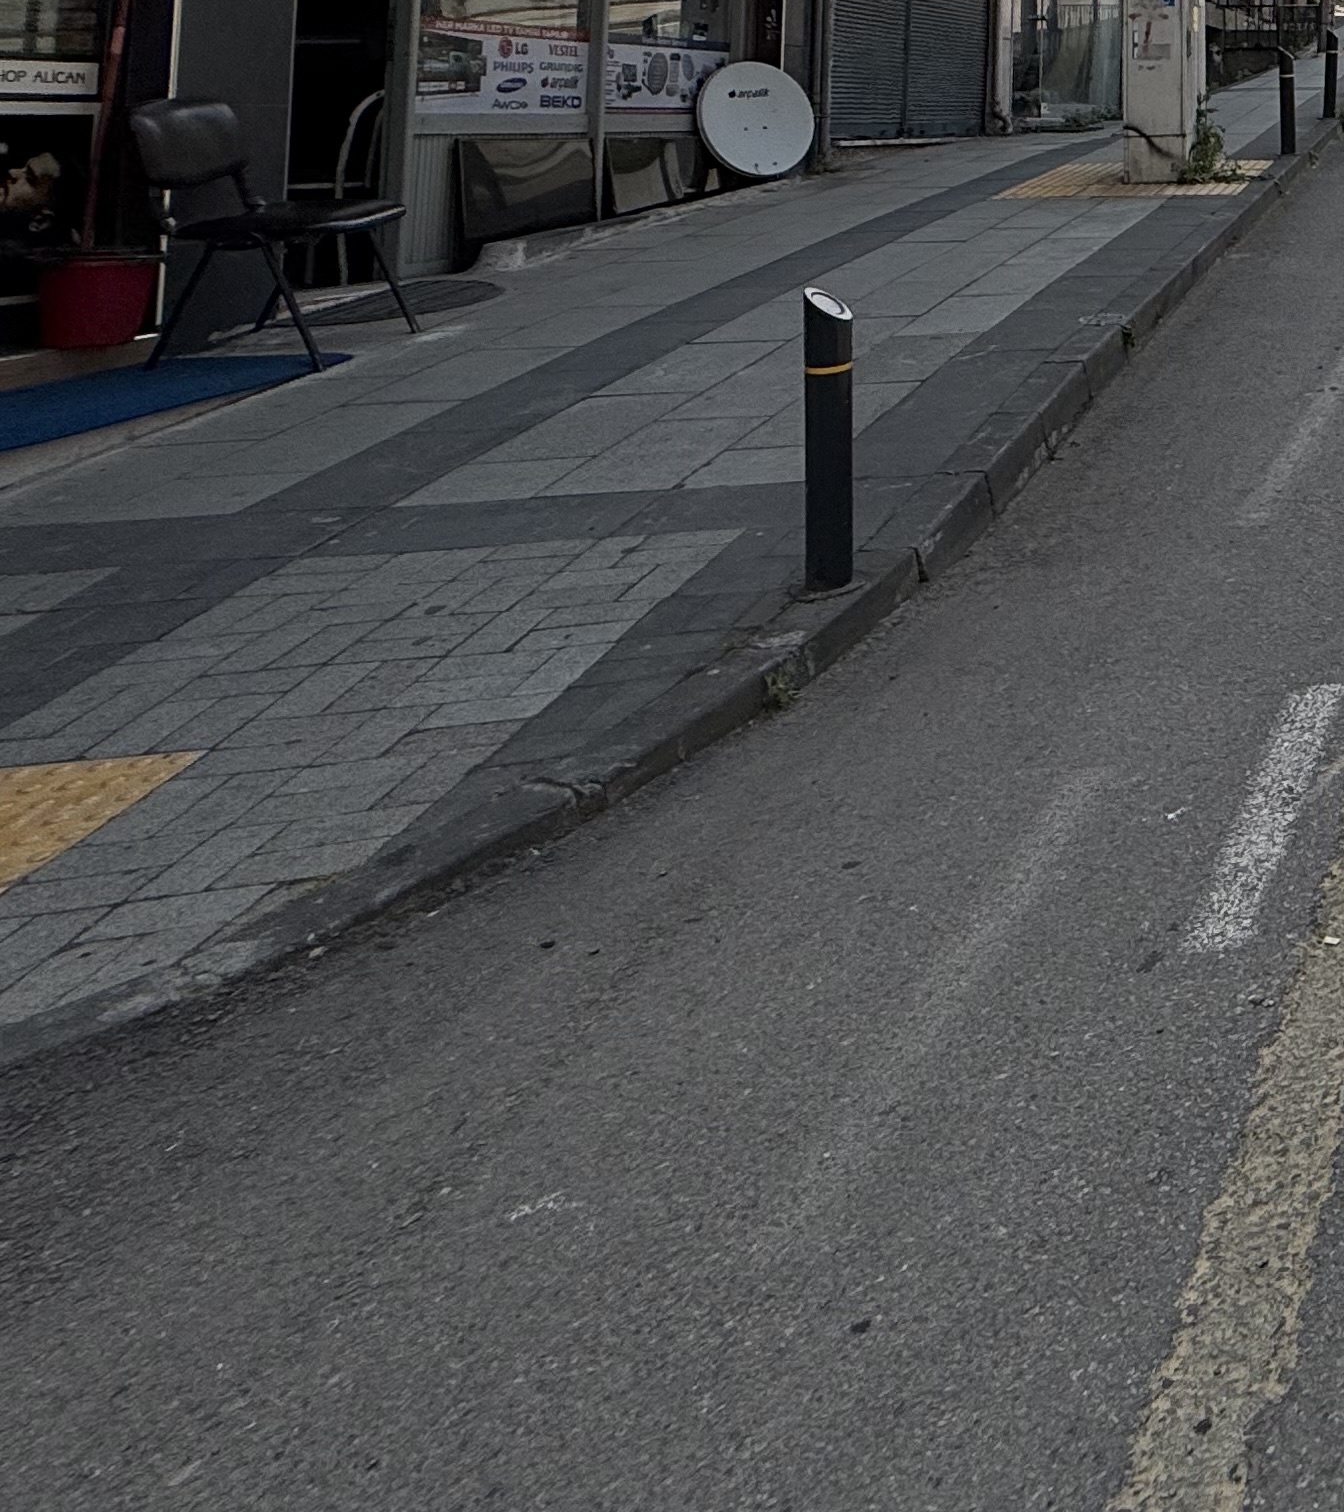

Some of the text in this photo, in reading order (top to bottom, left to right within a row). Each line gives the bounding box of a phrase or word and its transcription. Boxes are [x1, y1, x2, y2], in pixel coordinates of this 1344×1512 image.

[515, 42, 529, 56] LG
[548, 43, 579, 58] VESTEL
[493, 61, 534, 74] PHILIPS
[539, 61, 583, 73] GRUNDIG
[539, 94, 582, 109] BEKO
